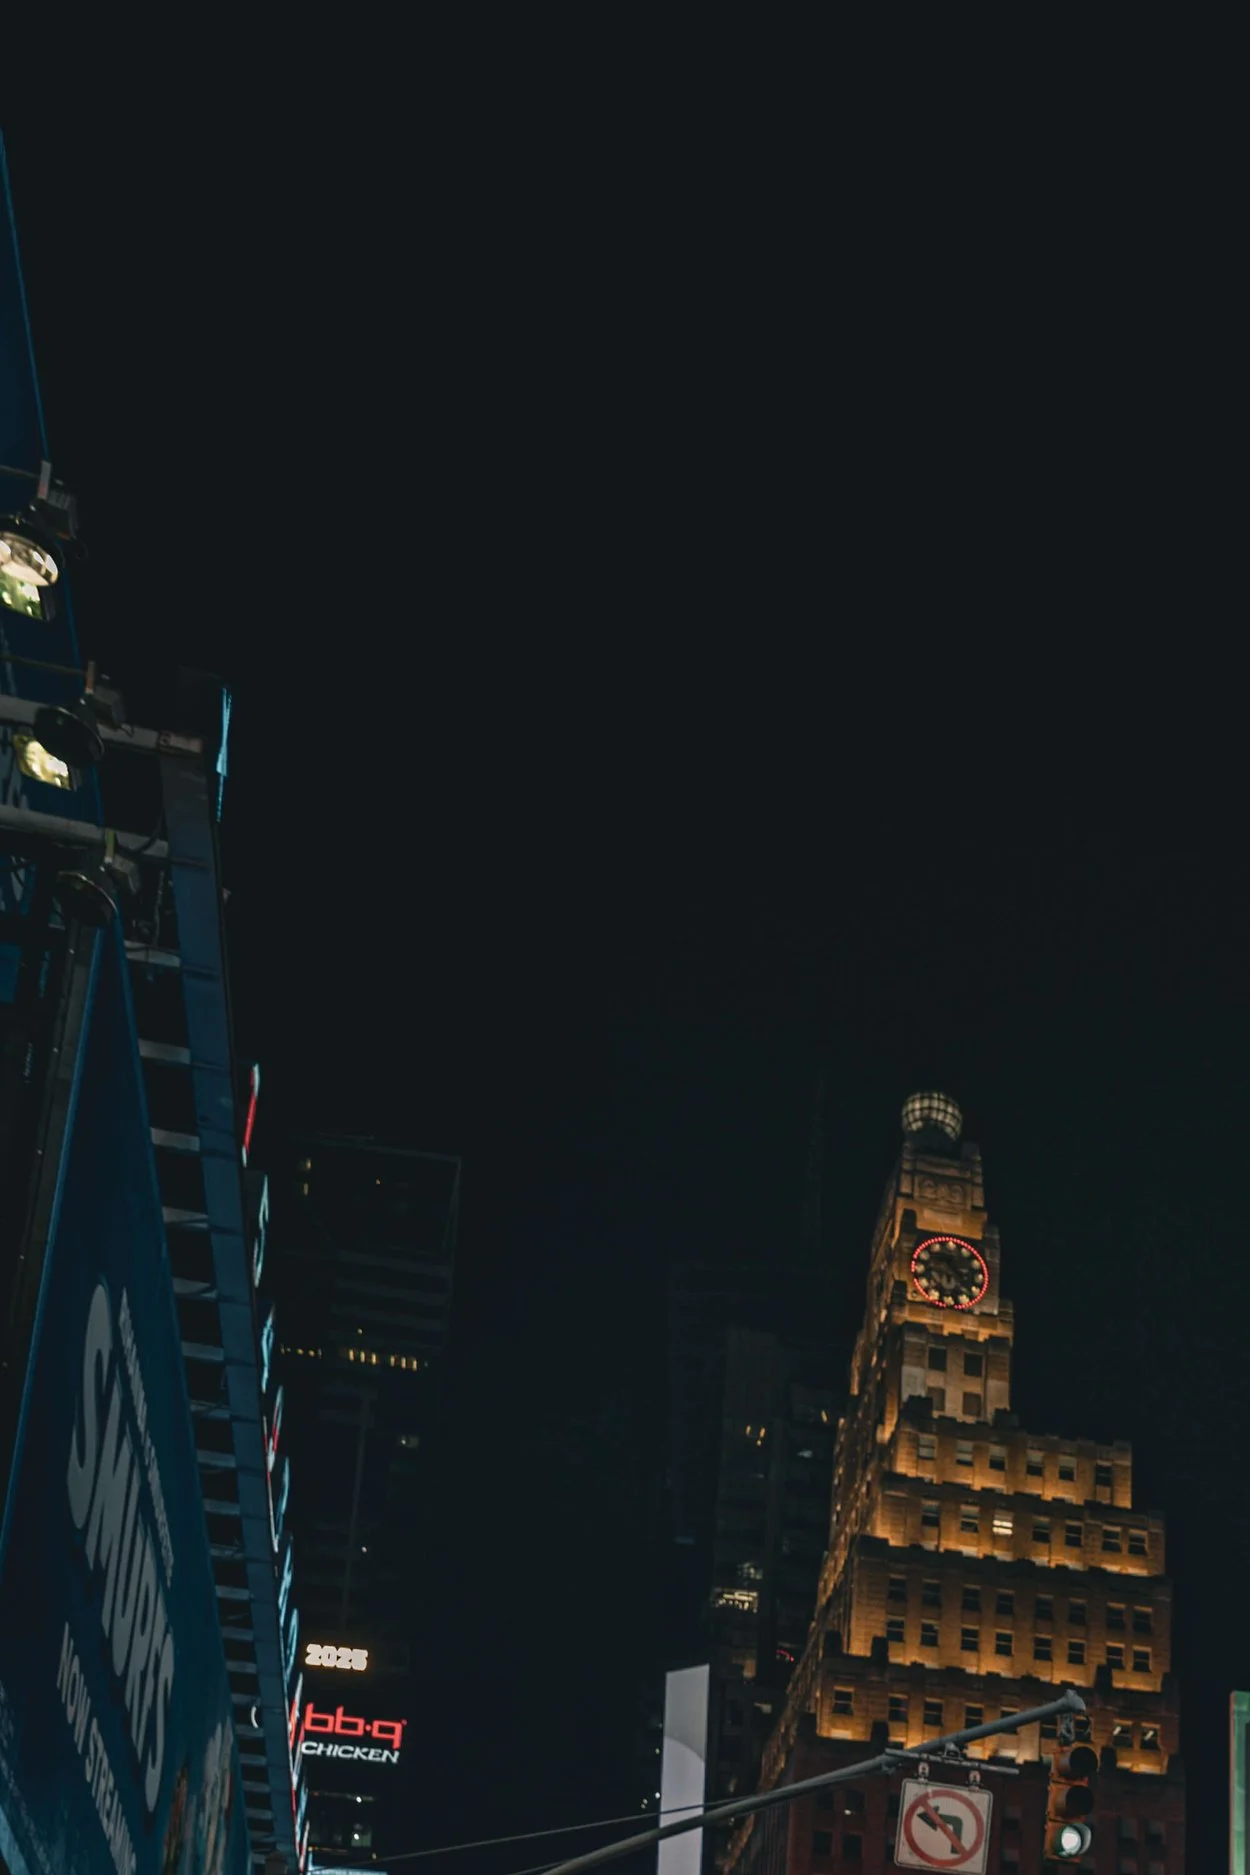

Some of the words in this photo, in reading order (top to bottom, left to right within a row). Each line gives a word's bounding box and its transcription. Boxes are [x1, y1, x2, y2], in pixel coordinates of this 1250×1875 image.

[67, 1284, 174, 1814] SMURFS
[57, 1621, 91, 1756] NOW
[305, 1643, 368, 1671] 2025
[301, 1740, 400, 1764] CHICKEN
